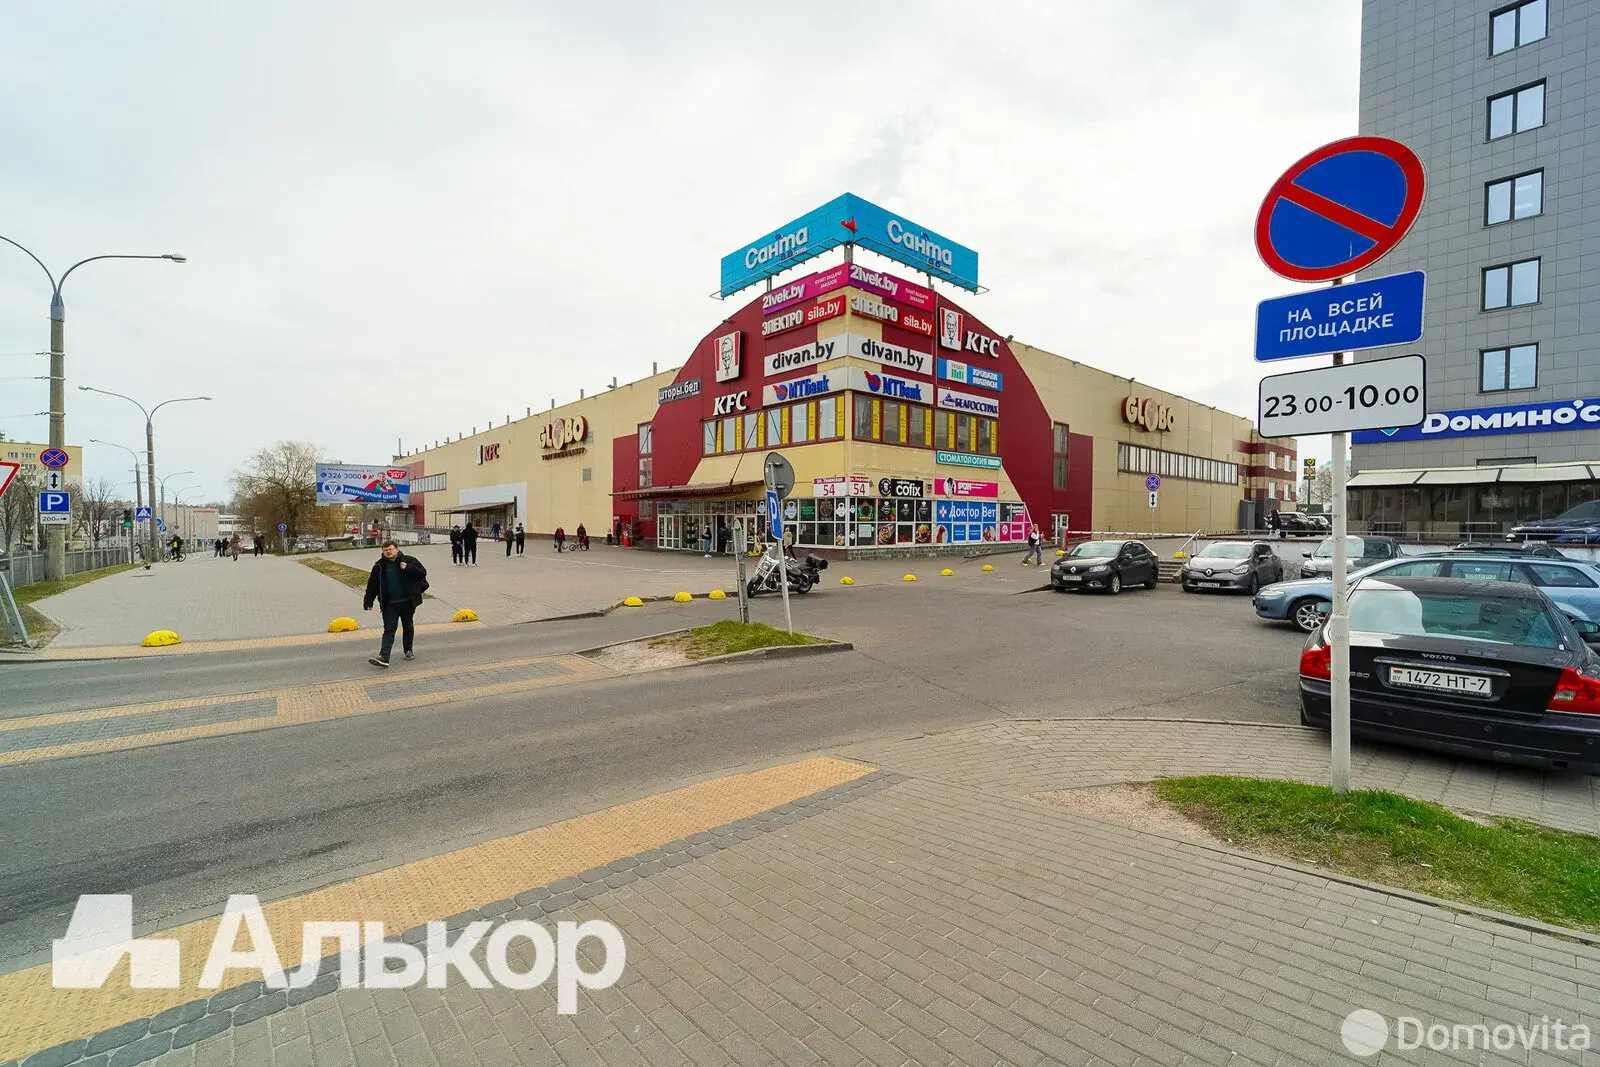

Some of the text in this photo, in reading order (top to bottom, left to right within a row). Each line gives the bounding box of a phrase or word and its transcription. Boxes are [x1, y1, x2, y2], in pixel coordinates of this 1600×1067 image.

[745, 226, 808, 269] Санта
[887, 220, 952, 265] Санта
[762, 301, 840, 336] ЭЛЕКТРО sila.by
[851, 296, 932, 335] ЭЛЕКТРО sila.by
[1287, 292, 1383, 324] НА ВСЕЙ
[1280, 313, 1394, 342] ПЛОЩАДКЕ
[772, 342, 835, 369] divan.by
[861, 339, 924, 372] divan.by
[965, 331, 1001, 358] KFC
[788, 375, 830, 399] МТБанк
[882, 376, 922, 401] МТБанк
[713, 391, 749, 416] KFC
[1123, 395, 1176, 432] GLOBO
[540, 415, 586, 449] GLOBO
[484, 443, 500, 461] KFC
[939, 453, 987, 465] СТОМАТОЛОГИЯ
[823, 483, 835, 496] 54
[853, 483, 865, 496] 54
[896, 483, 921, 497] cofix
[47, 494, 64, 511] P
[949, 505, 980, 519] Доктор
[982, 505, 996, 518] Вет
[1422, 653, 1457, 661] VOLVO
[1406, 671, 1441, 686] 1472
[1447, 676, 1487, 691] HT-7
